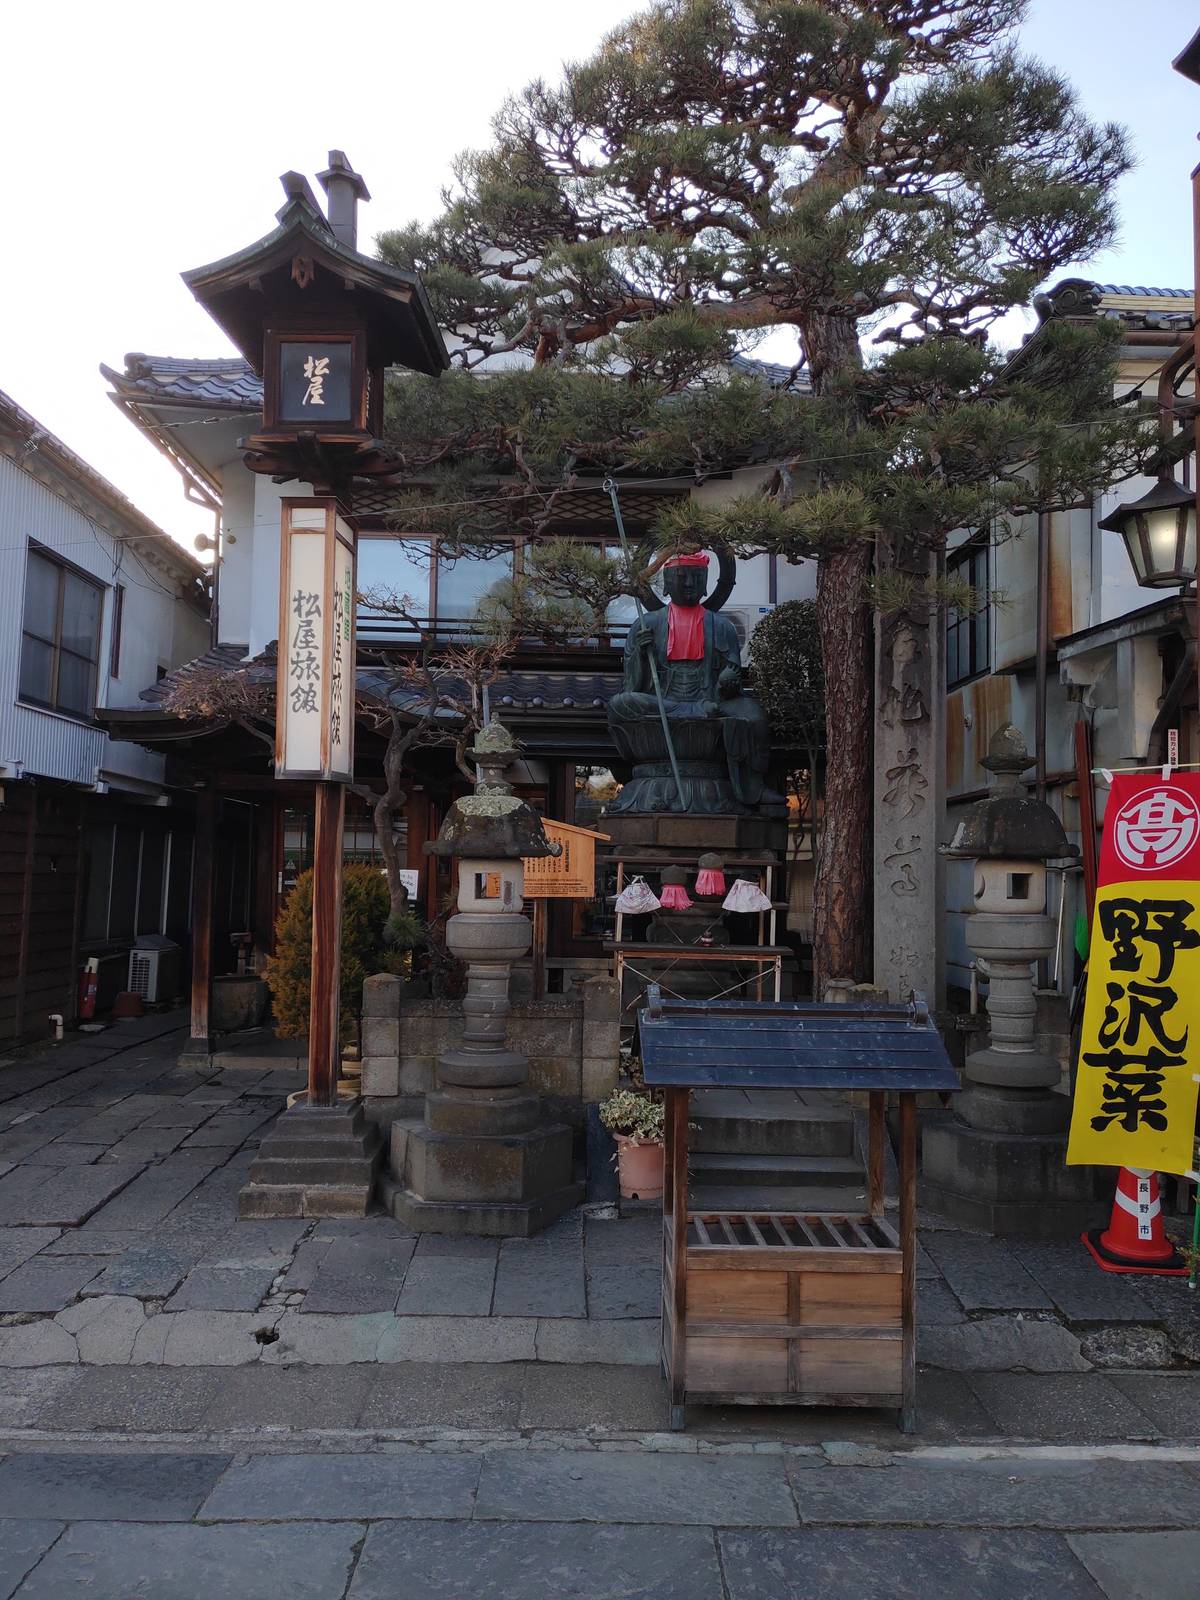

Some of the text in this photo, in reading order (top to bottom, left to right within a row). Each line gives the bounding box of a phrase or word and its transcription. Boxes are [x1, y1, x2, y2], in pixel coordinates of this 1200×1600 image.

[302, 355, 330, 406] 松屋
[1082, 897, 1200, 1132] 野沢菜
[1139, 1182, 1150, 1235] 長野市
